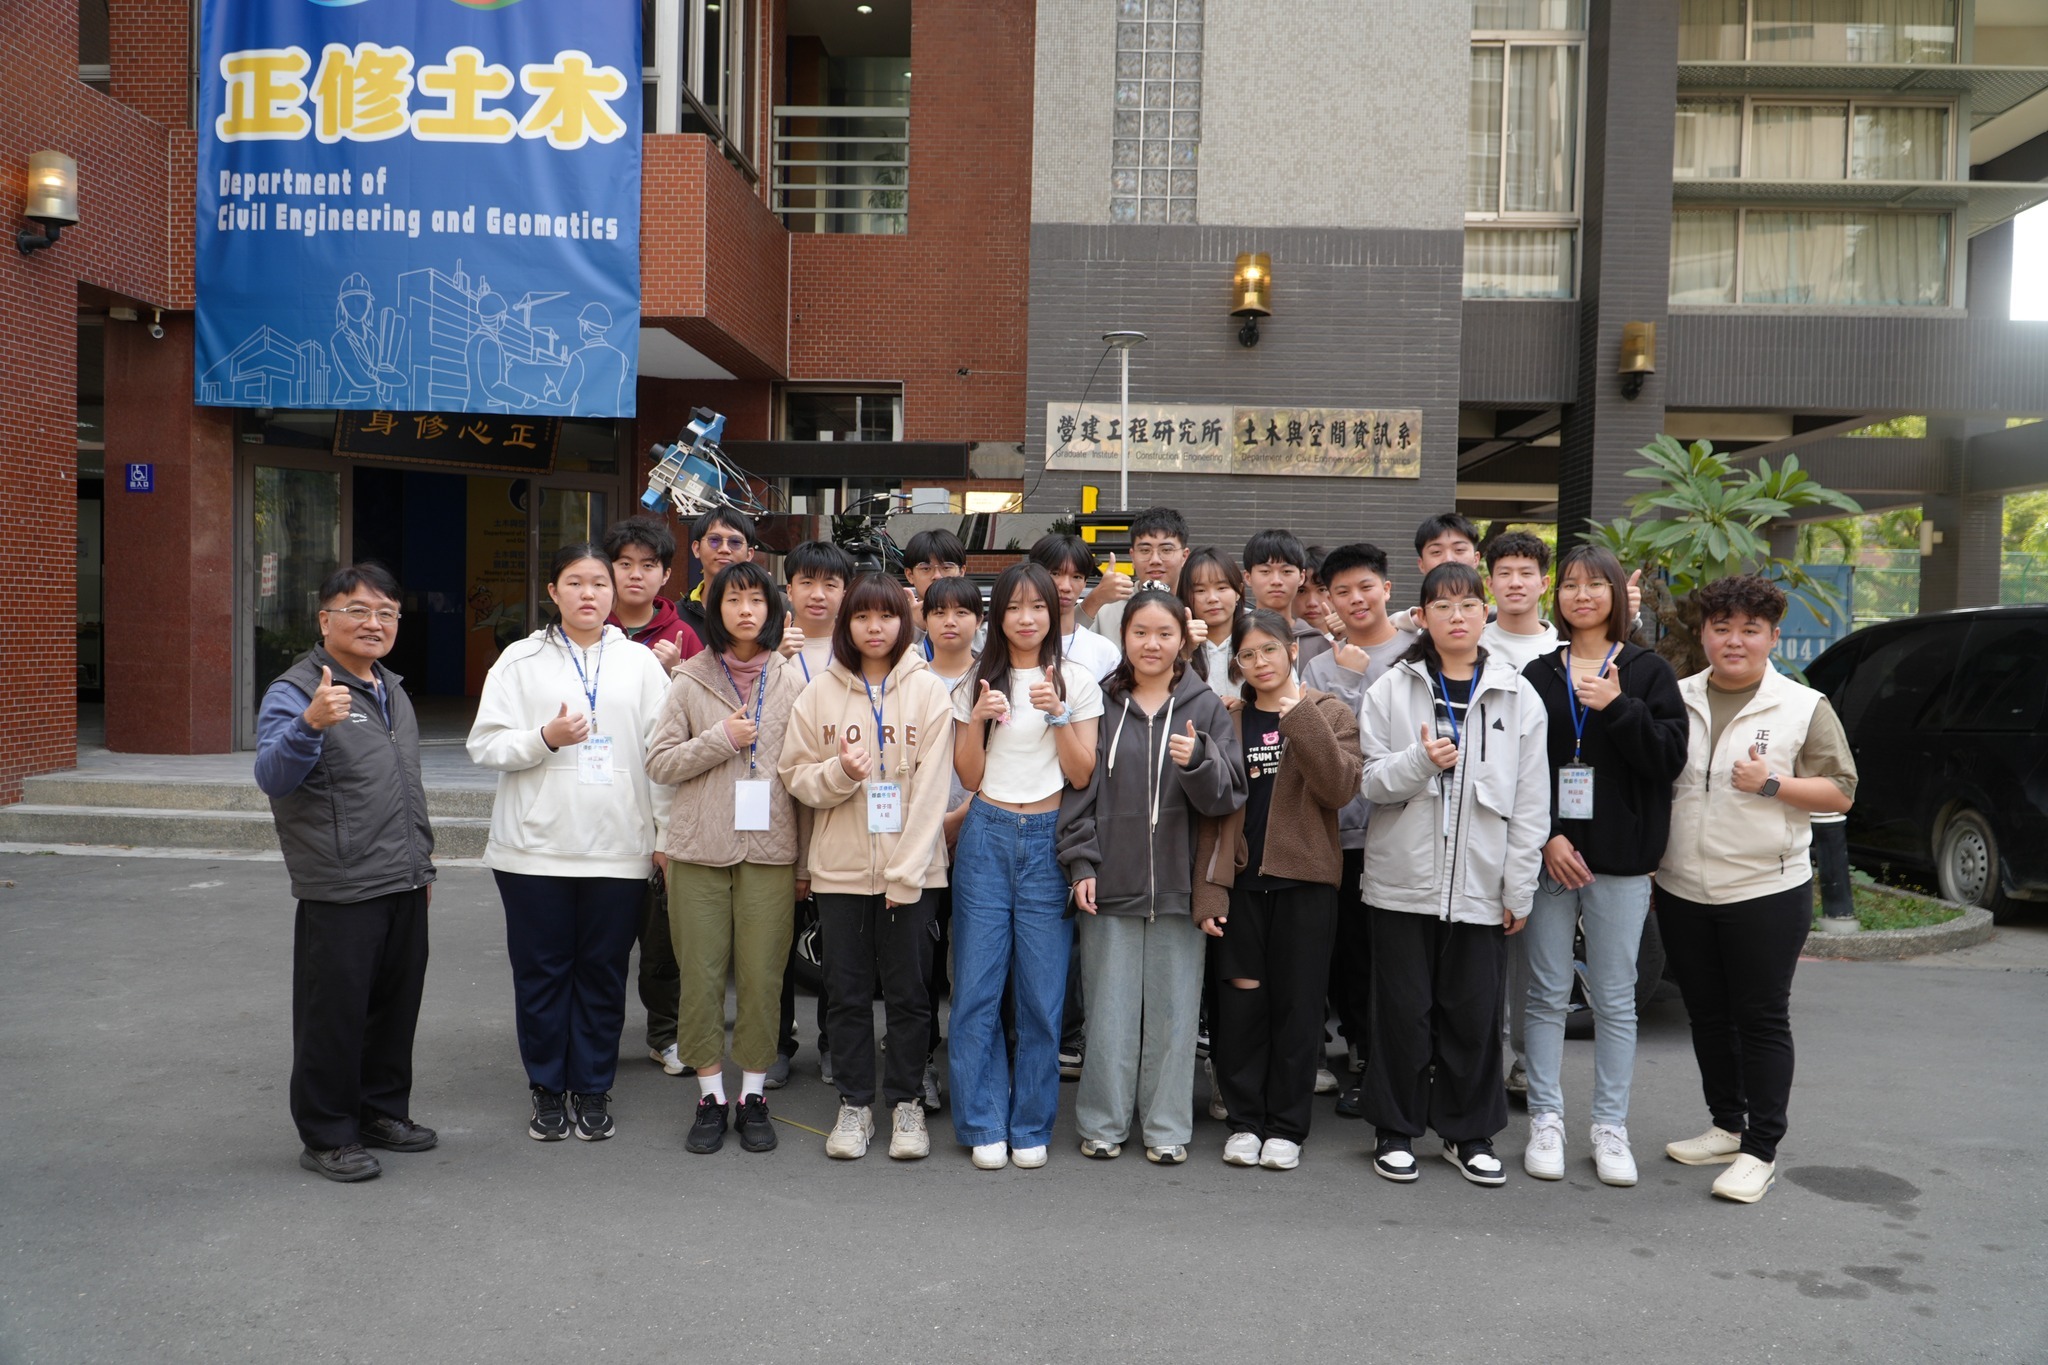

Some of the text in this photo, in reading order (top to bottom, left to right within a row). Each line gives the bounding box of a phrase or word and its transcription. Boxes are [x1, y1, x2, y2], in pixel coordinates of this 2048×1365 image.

[216, 42, 627, 150] 正修土木
[219, 167, 387, 201] Department of
[217, 203, 618, 240] Civil Engineering and Geomatics
[1056, 414, 1223, 446] 營建工程研究所
[1243, 419, 1411, 450] 土木與空間資訊系
[1092, 451, 1118, 459] Institute
[1135, 452, 1179, 460] Construction
[1183, 452, 1223, 463] Engineering
[1241, 453, 1282, 462] Department
[1285, 453, 1293, 462] of
[822, 724, 917, 746] MORE
[1247, 752, 1272, 763] TSUM
